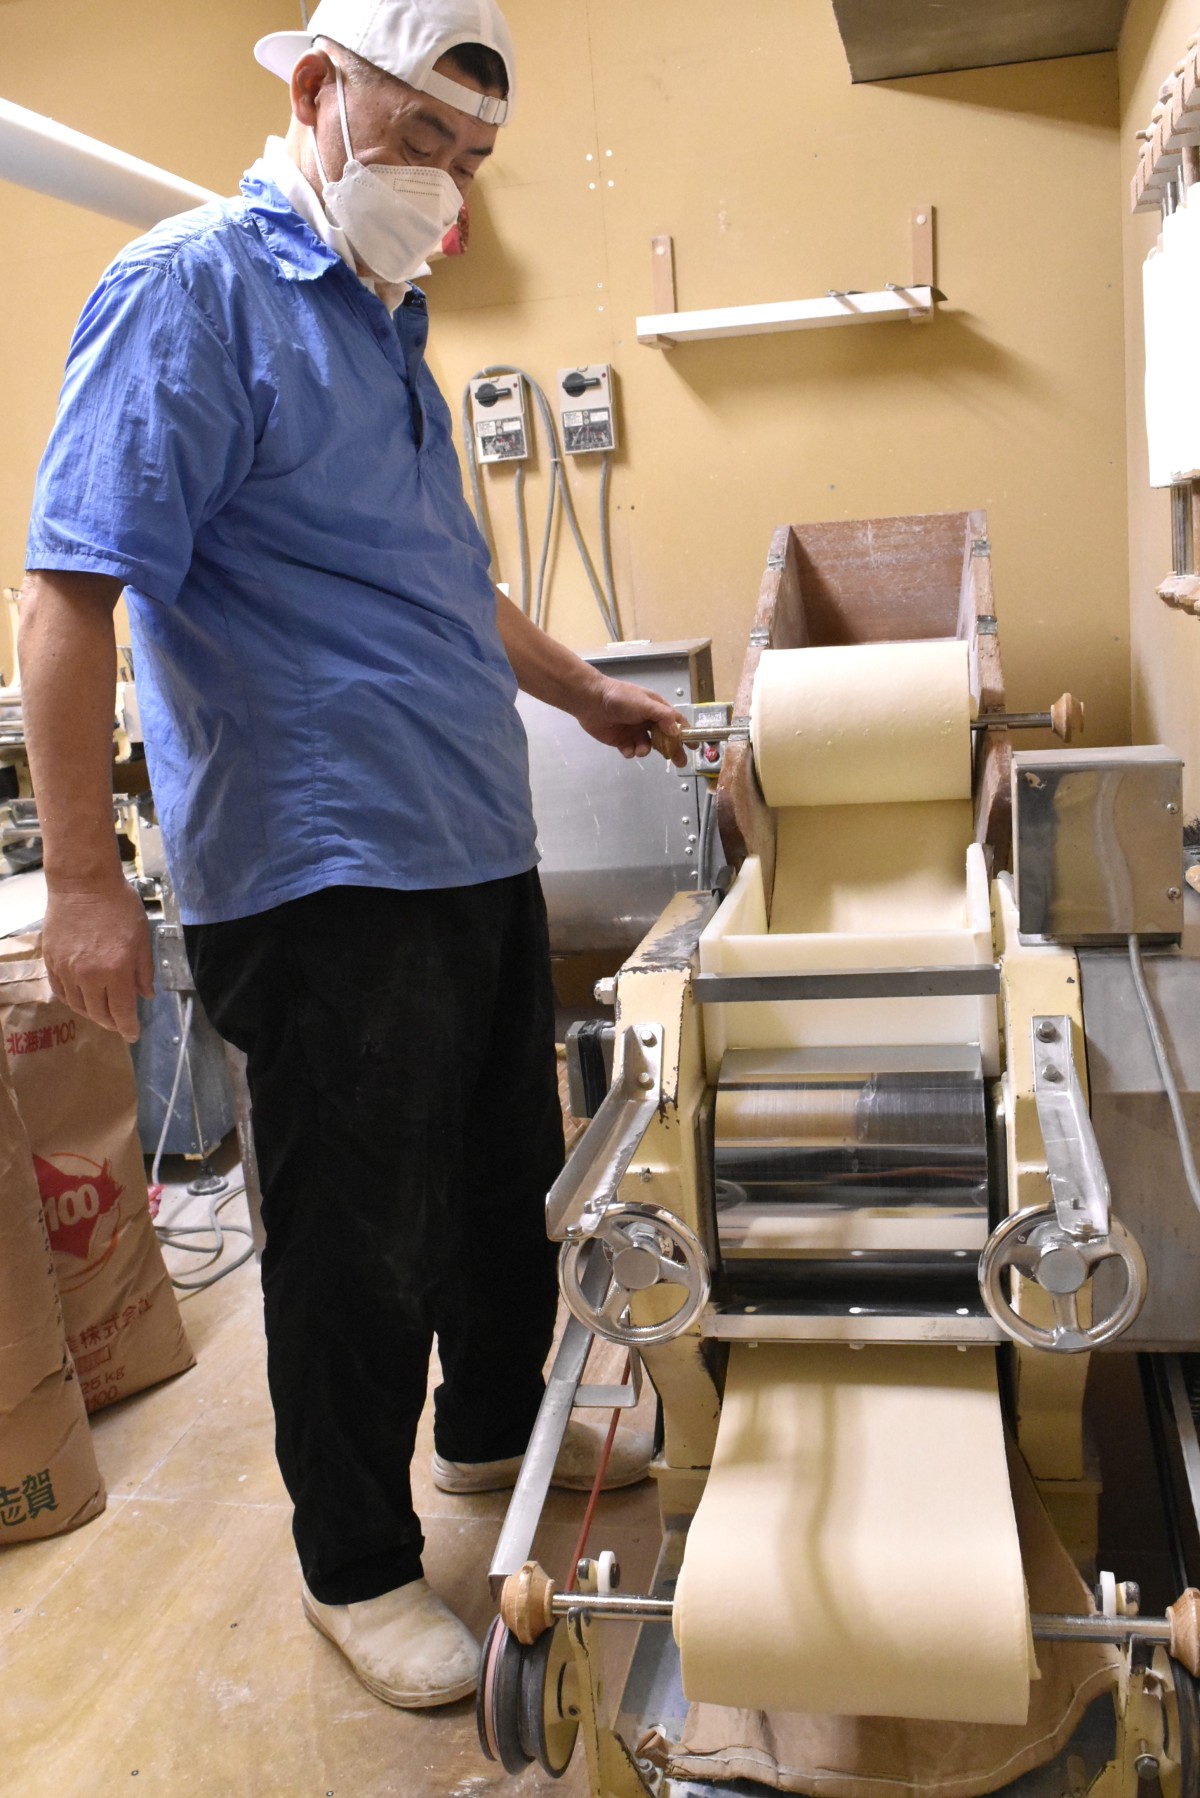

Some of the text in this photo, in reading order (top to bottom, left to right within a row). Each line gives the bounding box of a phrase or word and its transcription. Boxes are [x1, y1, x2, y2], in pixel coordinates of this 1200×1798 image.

[6, 1019, 76, 1055] 北海道100
[44, 1183, 100, 1231] 100
[80, 1365, 125, 1395] 25 kg
